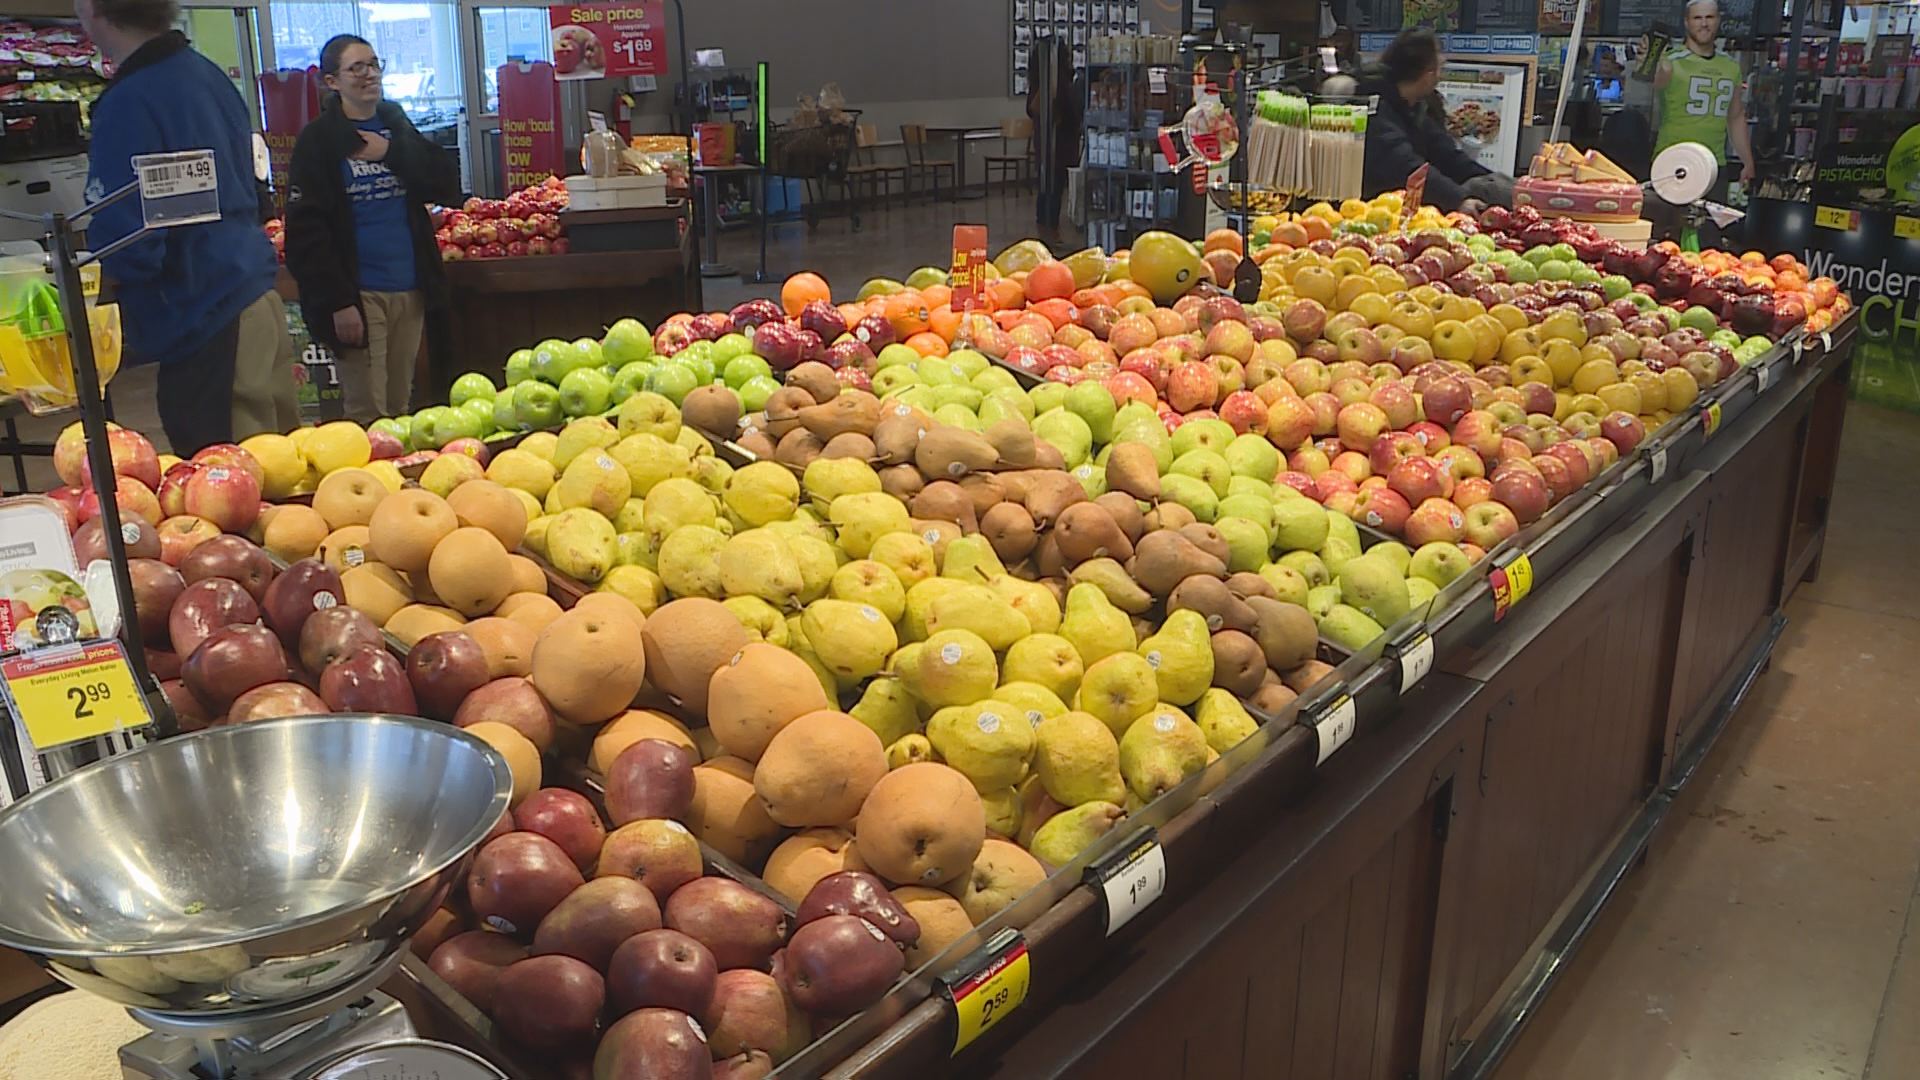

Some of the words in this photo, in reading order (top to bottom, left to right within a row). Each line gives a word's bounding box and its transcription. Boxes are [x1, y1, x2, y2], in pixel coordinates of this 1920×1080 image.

[571, 8, 603, 22] Sale
[607, 7, 644, 24] price
[1686, 75, 1734, 117] 52
[503, 119, 526, 132] How
[527, 118, 555, 132] 'bout
[506, 150, 531, 165] low
[1837, 154, 1883, 165] Wonderful
[1818, 167, 1886, 182] PISTACHIO
[321, 389, 341, 400] ev
[30, 675, 60, 686] Everyday
[61, 671, 81, 680] Living
